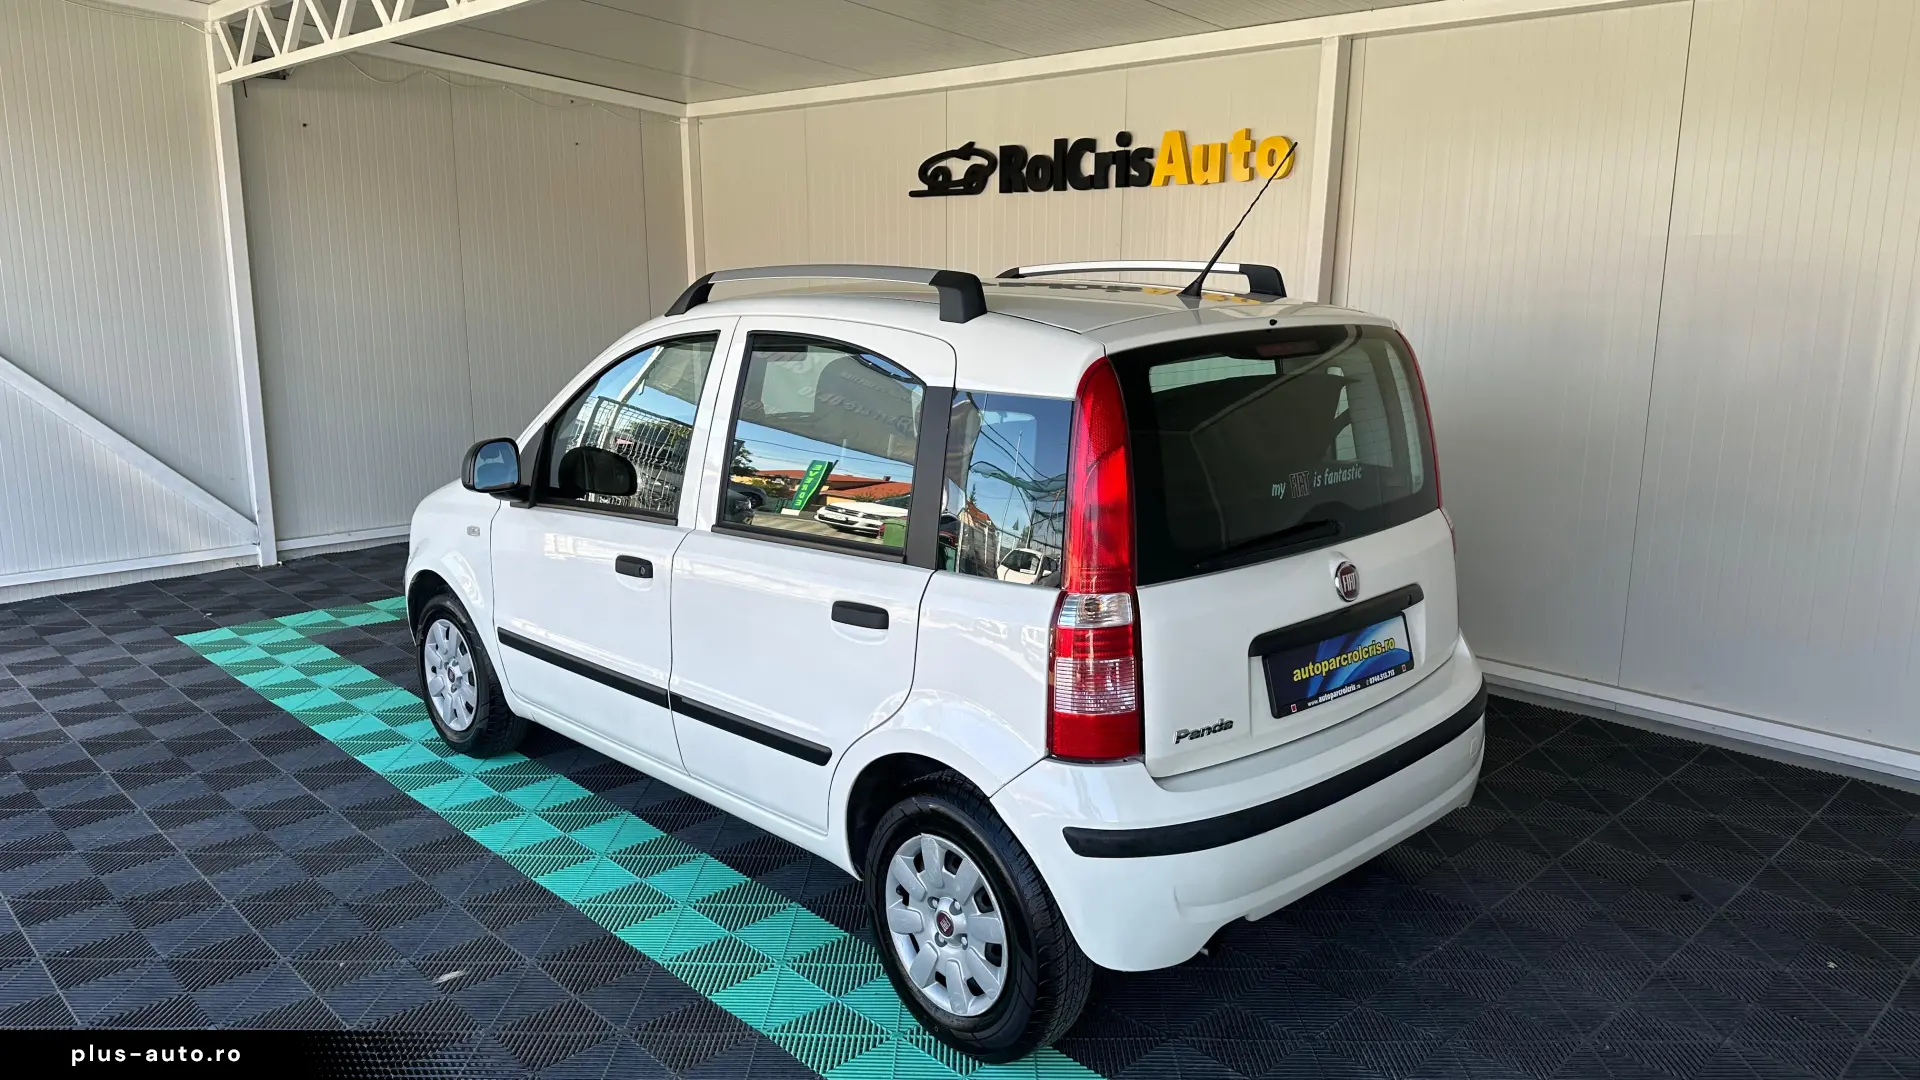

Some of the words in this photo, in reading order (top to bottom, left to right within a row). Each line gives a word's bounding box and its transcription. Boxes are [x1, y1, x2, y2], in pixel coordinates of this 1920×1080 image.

[1271, 482, 1286, 499] my
[1289, 471, 1310, 498] FIAT
[1313, 471, 1322, 488] is
[1324, 463, 1362, 486] fantastic
[1342, 573, 1356, 592] FIAT
[1293, 637, 1395, 682] autoparcrolcris.ro
[1173, 717, 1234, 744] Panda
